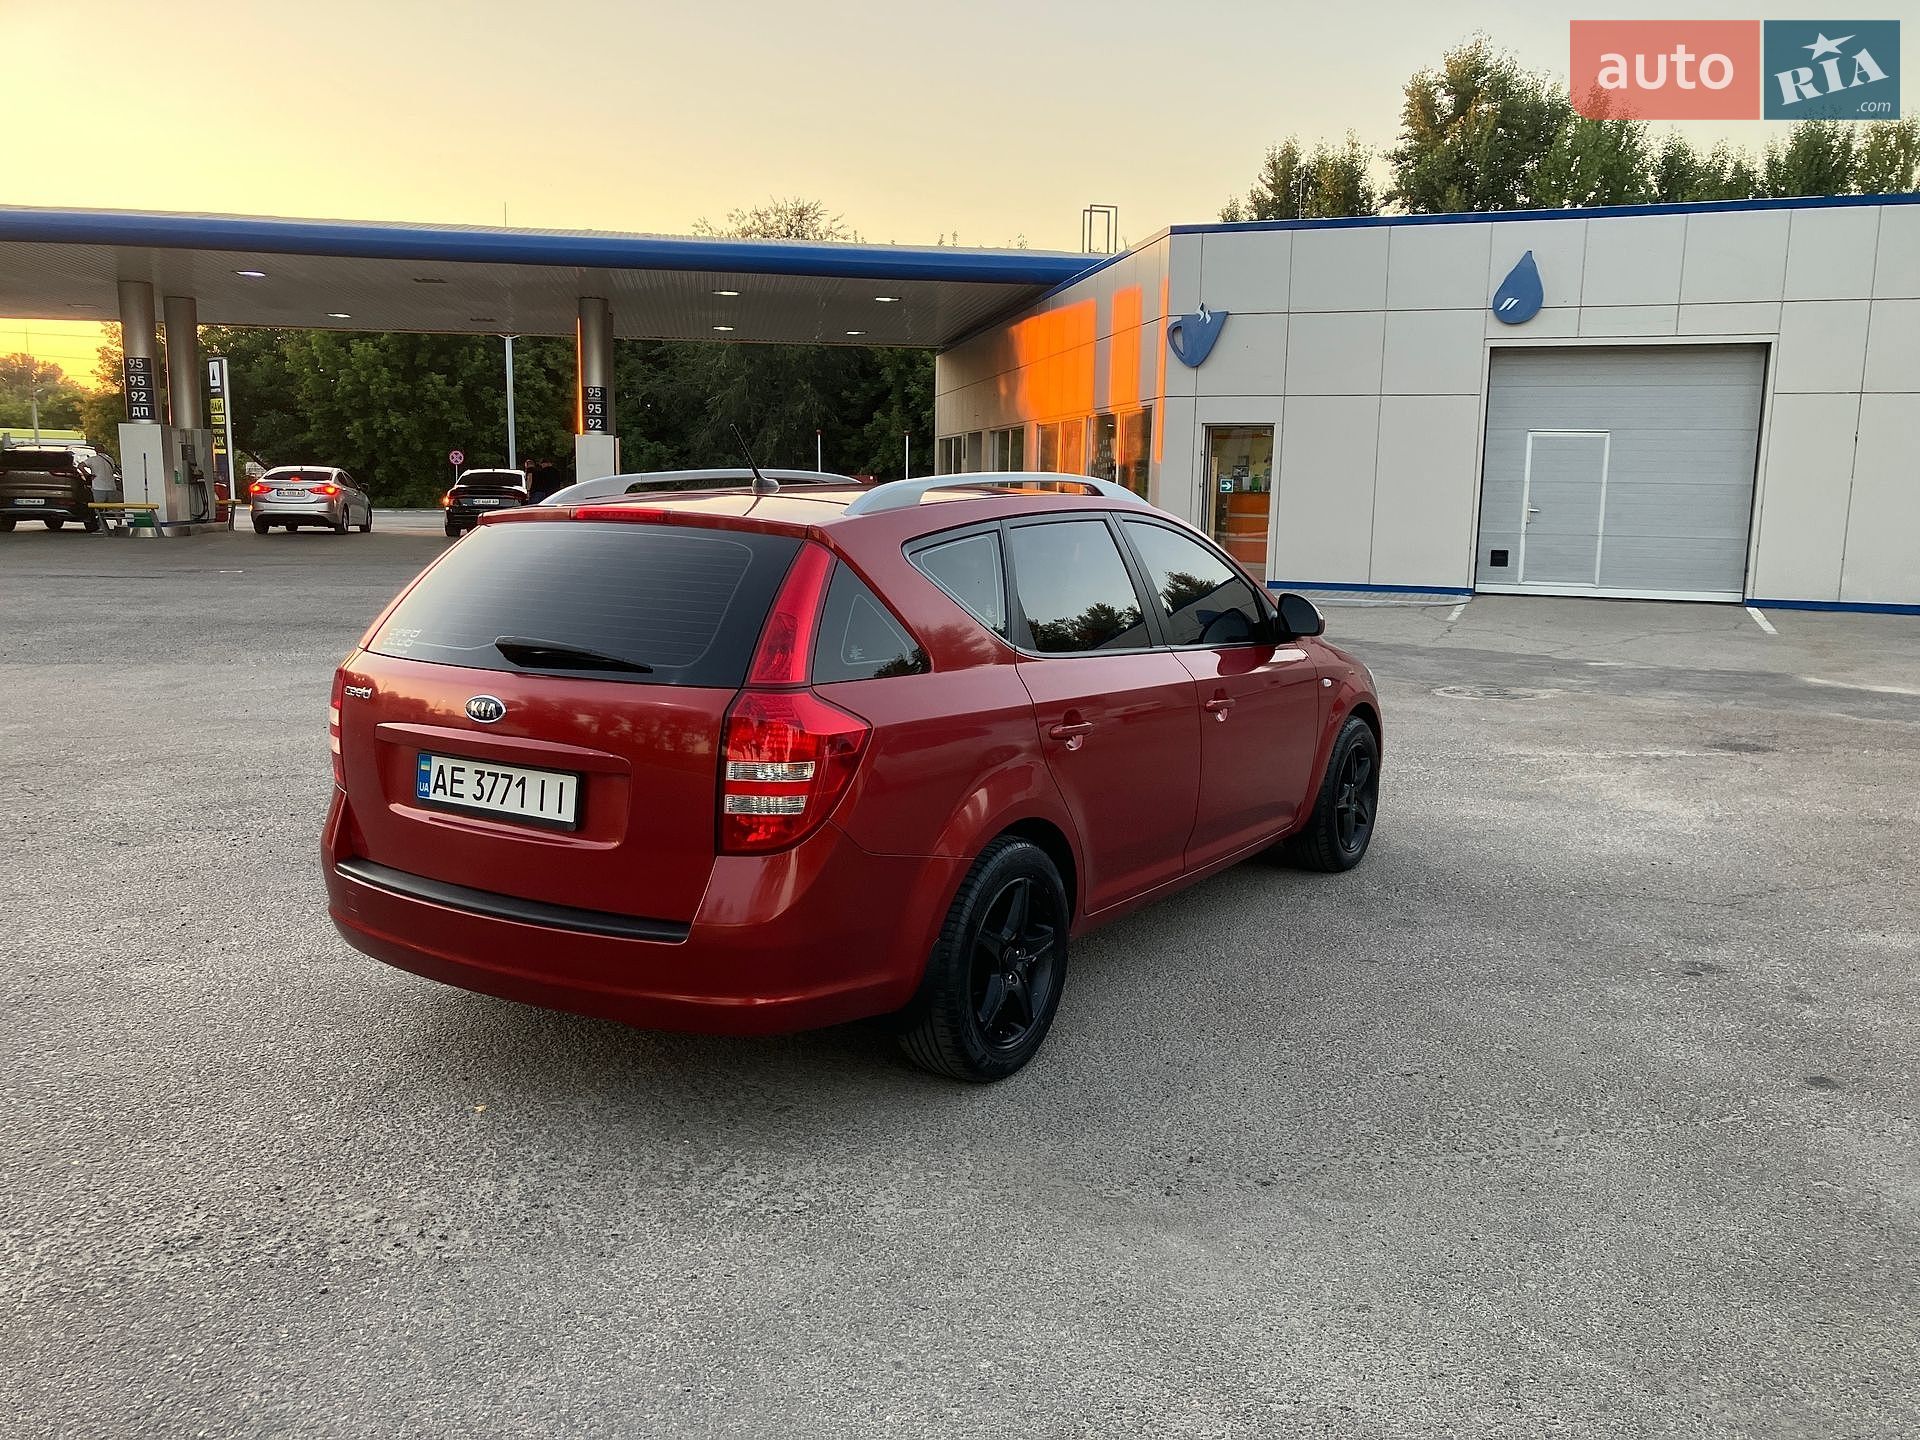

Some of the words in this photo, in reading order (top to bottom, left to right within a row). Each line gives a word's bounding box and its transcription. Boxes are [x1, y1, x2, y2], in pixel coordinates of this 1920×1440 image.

[128, 358, 144, 369] 95
[130, 375, 146, 386] 95
[131, 391, 147, 402] 92
[587, 387, 602, 397] 95
[132, 406, 149, 417] ДП
[587, 403, 602, 414] 95
[587, 418, 602, 429] 92
[470, 700, 498, 718] KIA
[419, 783, 429, 793] UA
[432, 764, 465, 798] AE
[472, 769, 527, 808] 3771
